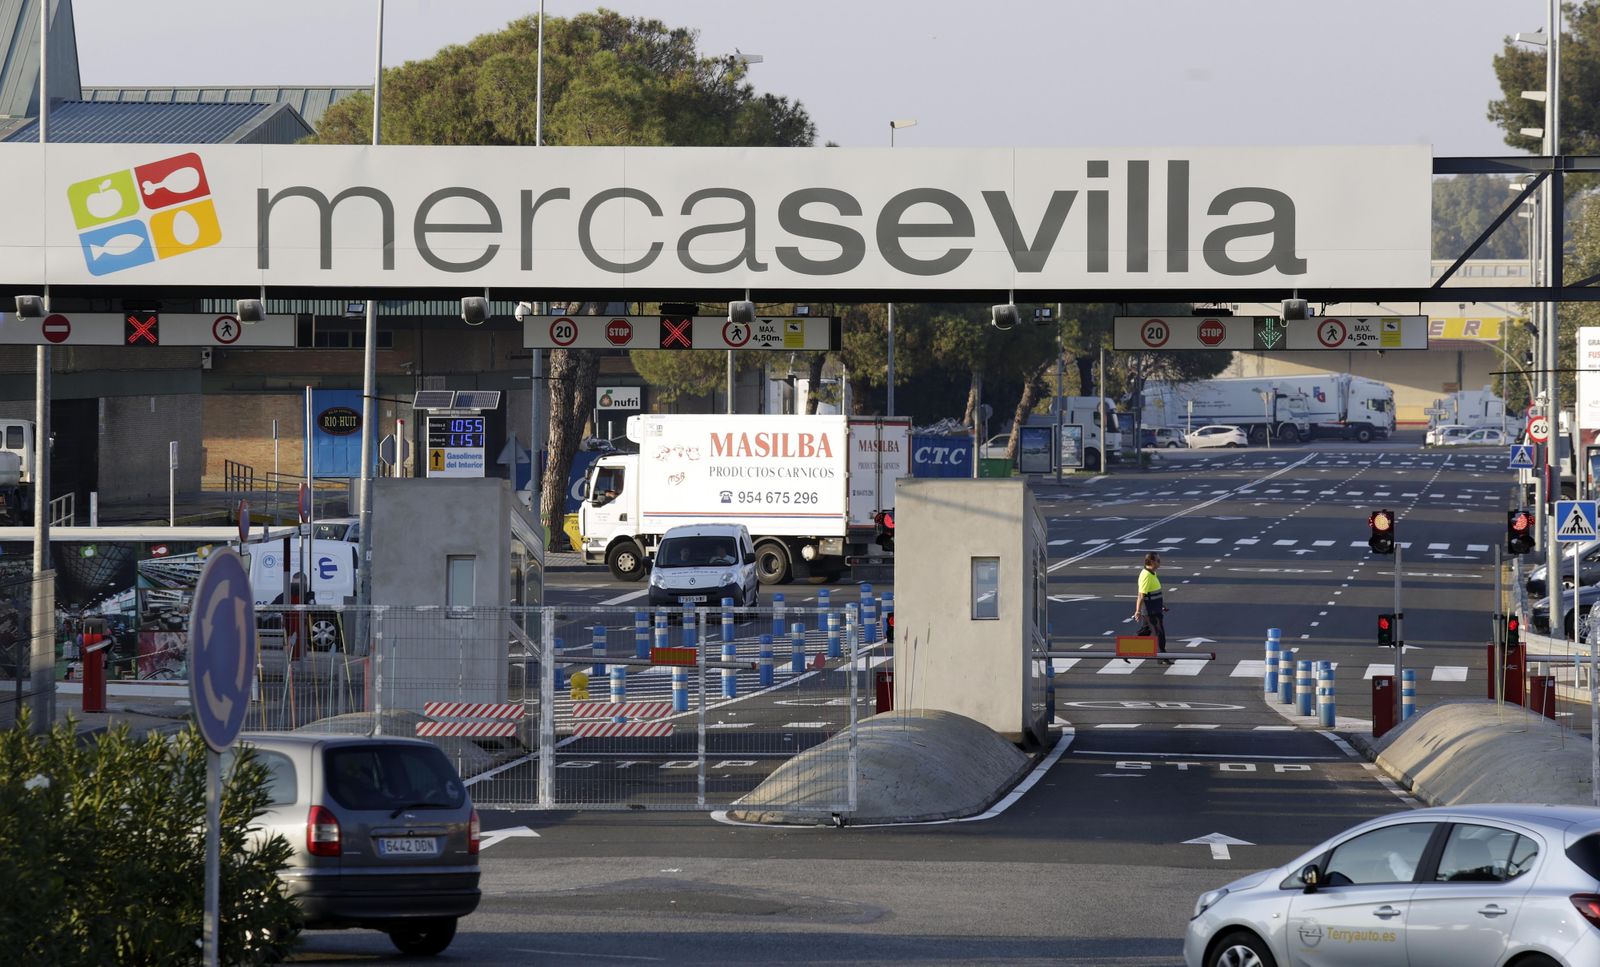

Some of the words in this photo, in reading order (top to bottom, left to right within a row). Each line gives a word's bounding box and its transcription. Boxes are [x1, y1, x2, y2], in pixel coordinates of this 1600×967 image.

[258, 160, 1307, 277] mercasevilla
[556, 326, 572, 338] 20
[609, 327, 630, 337] STOP
[1147, 327, 1163, 339] 20
[1201, 328, 1222, 337] STOP
[614, 397, 639, 407] nufri
[1533, 424, 1548, 434] 20
[709, 432, 834, 458] MASILBA
[446, 452, 483, 460] Gasolinera
[446, 461, 457, 469] del
[459, 461, 483, 469] Interior
[709, 466, 776, 478] PRODUCTOS
[777, 467, 835, 479] CARNICOS
[738, 491, 763, 504] 954
[766, 491, 790, 504] 675
[793, 491, 819, 504] 296
[1115, 760, 1312, 773] STOP
[385, 840, 412, 853] 6442
[1327, 927, 1397, 944] Terryauto.es
